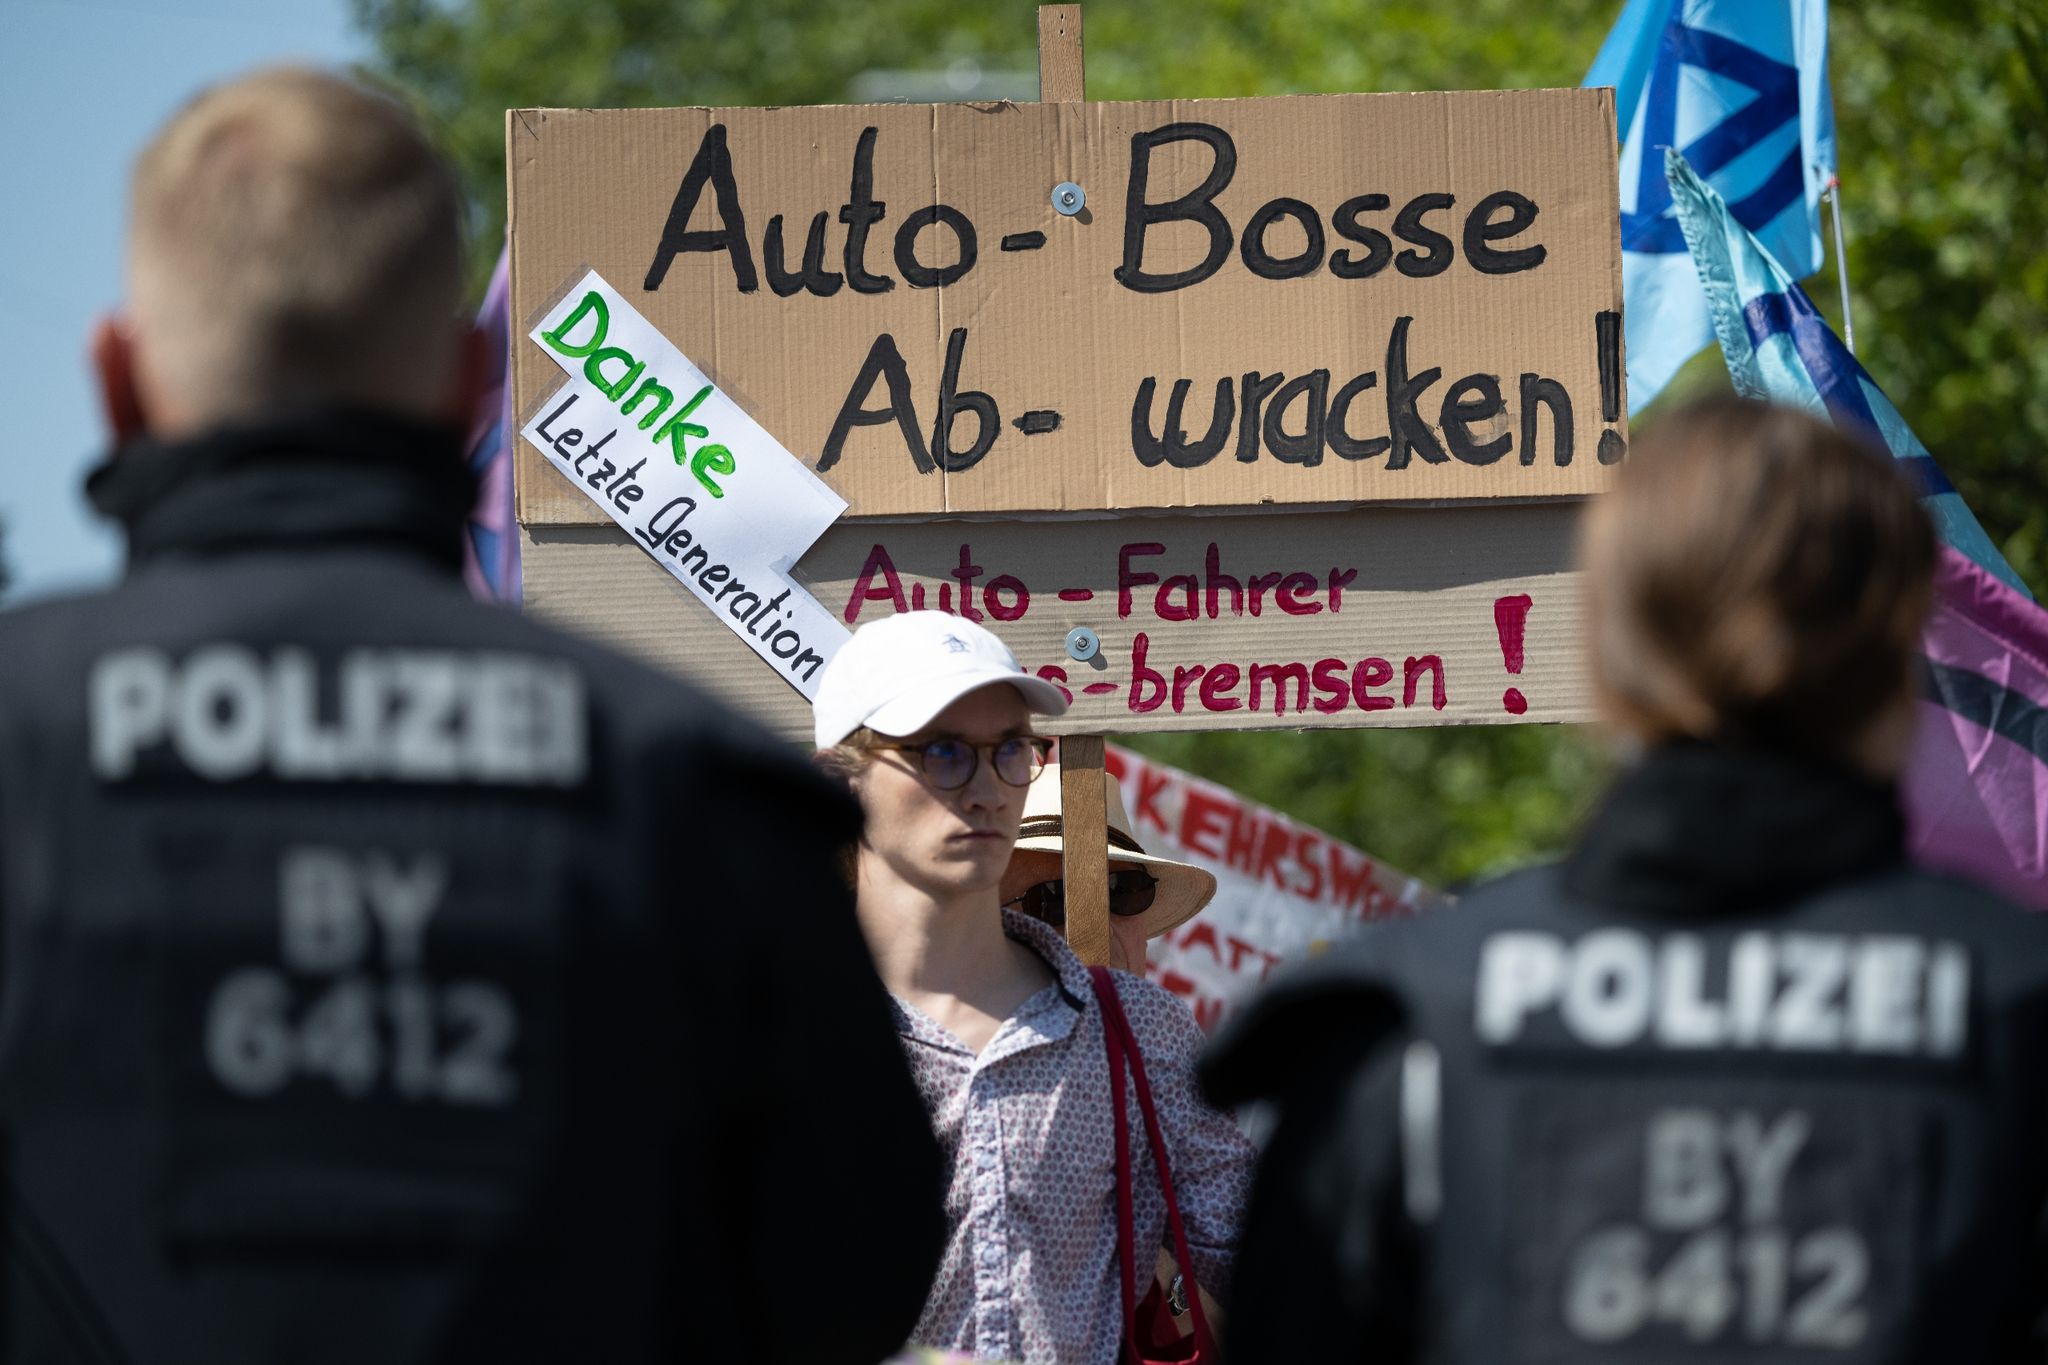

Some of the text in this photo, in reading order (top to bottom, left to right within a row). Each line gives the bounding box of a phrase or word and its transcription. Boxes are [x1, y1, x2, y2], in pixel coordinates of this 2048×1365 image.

[643, 121, 1547, 298] Auto- Bosse
[541, 290, 736, 499] Danke
[815, 327, 1061, 474] Ab-
[535, 393, 824, 683] Letzte Generation
[1118, 542, 1358, 622] Fahrer
[89, 644, 588, 788] POLIZEI
[279, 845, 448, 972] BY
[206, 968, 519, 1106] 6412
[1475, 928, 1972, 1057] POLIZEI
[1643, 1108, 1811, 1230] BY
[1566, 1226, 1871, 1348] 6412
